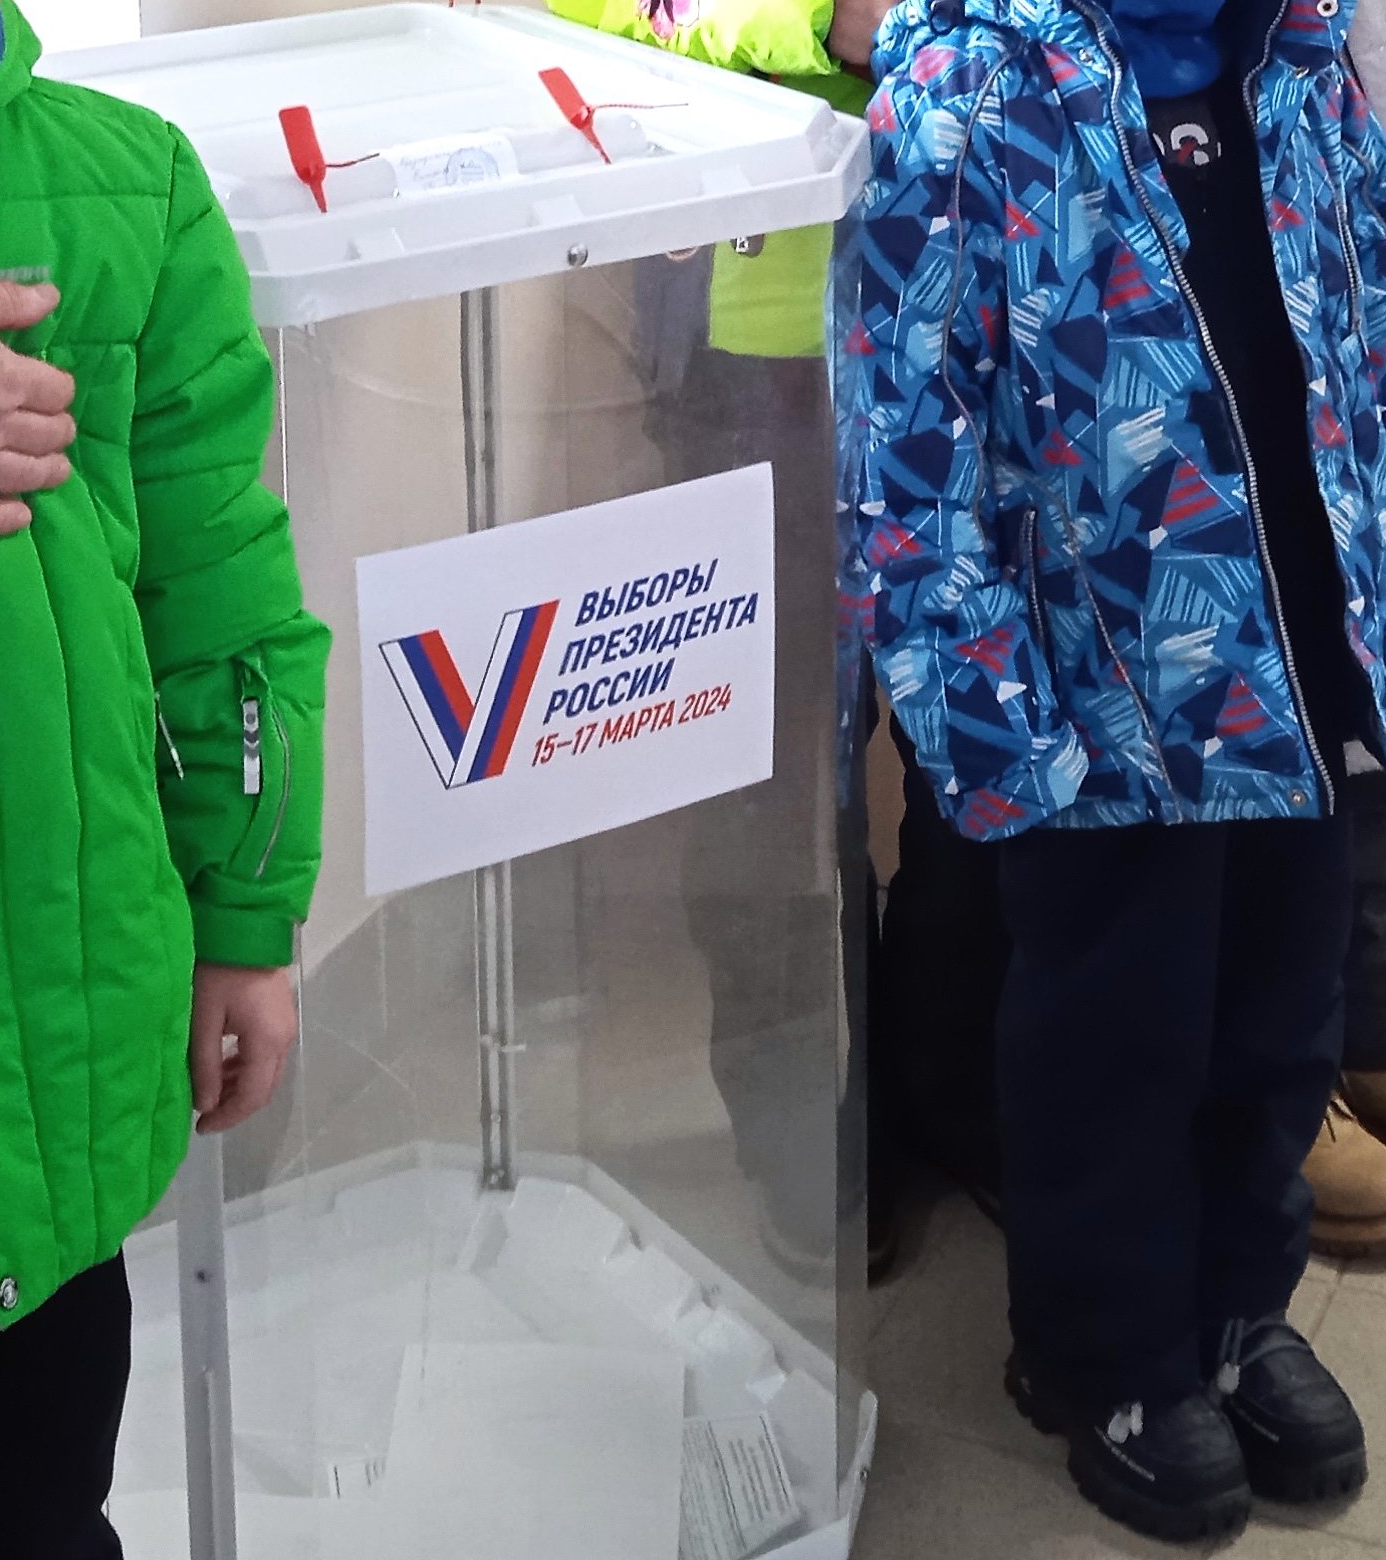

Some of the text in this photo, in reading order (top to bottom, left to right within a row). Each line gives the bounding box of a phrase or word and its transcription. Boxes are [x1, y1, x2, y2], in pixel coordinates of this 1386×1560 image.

[575, 558, 718, 627] ВЫБОРЫ
[558, 592, 759, 676] ПРЕЗИДЕНТА
[543, 657, 676, 726] РОССИИ
[598, 699, 676, 748] МАРТА
[677, 683, 732, 724] 2024
